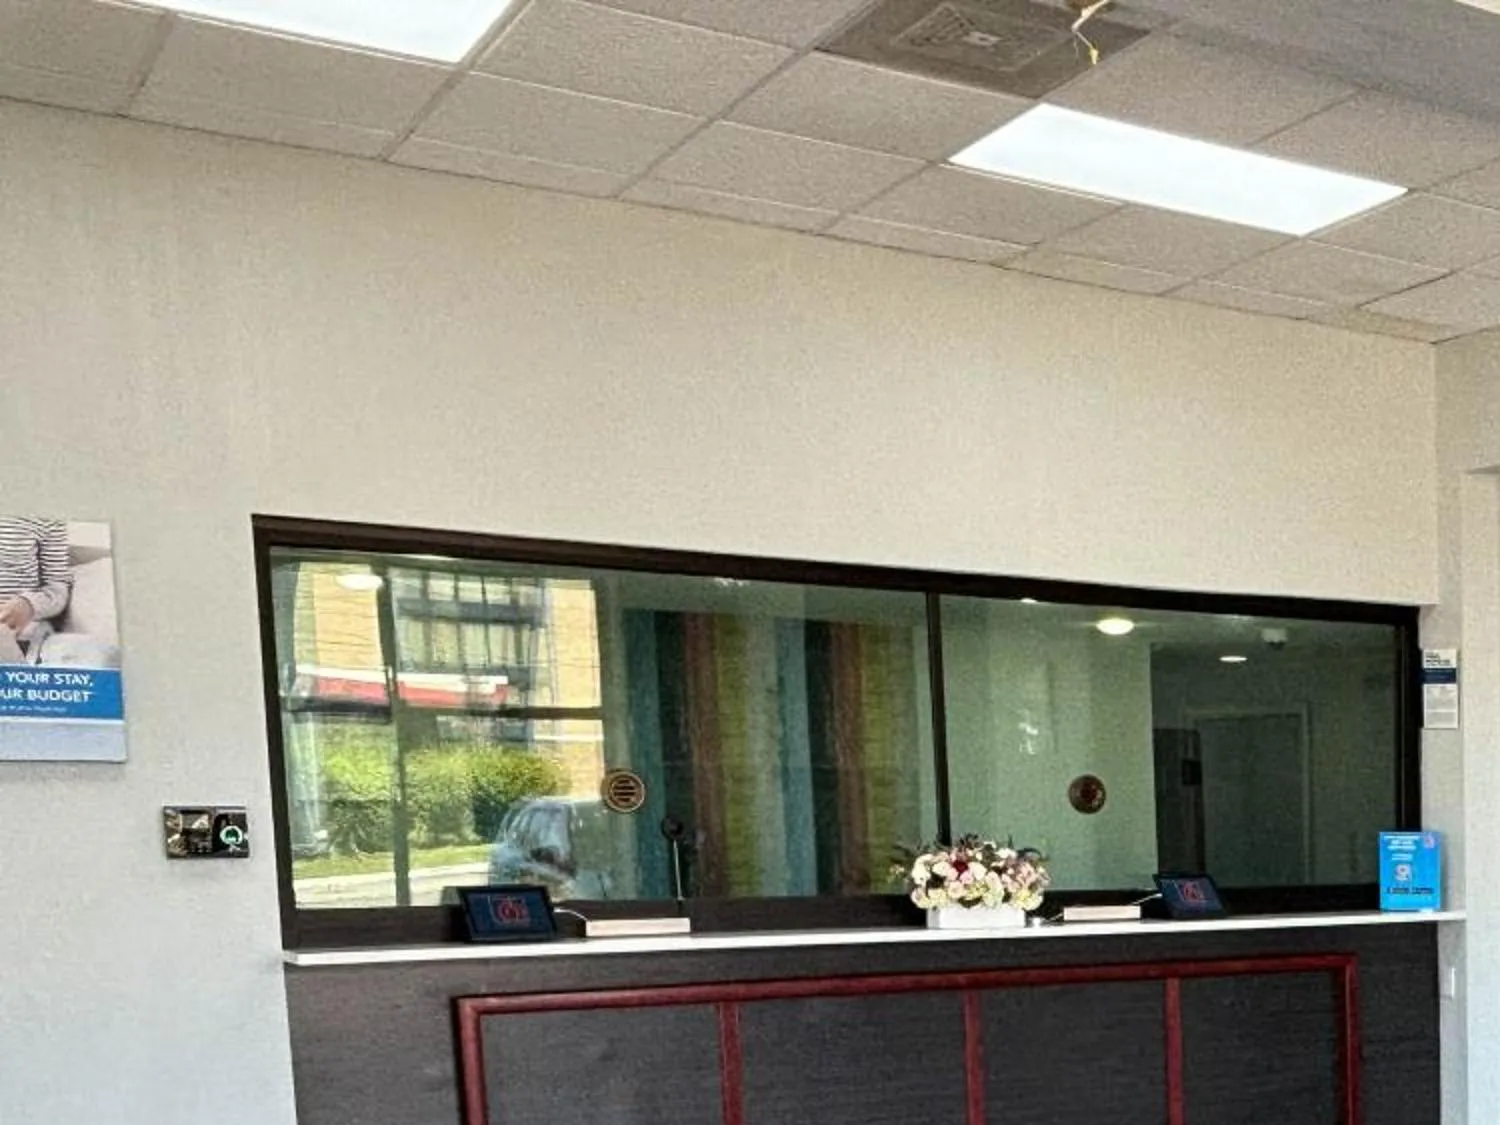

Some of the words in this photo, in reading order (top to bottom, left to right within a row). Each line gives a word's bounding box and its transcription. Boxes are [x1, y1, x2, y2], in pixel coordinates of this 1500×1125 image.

[5, 671, 50, 685] YOUR
[54, 673, 94, 687] STAY,
[0, 688, 24, 700] UR
[27, 689, 93, 703] BUDGET
